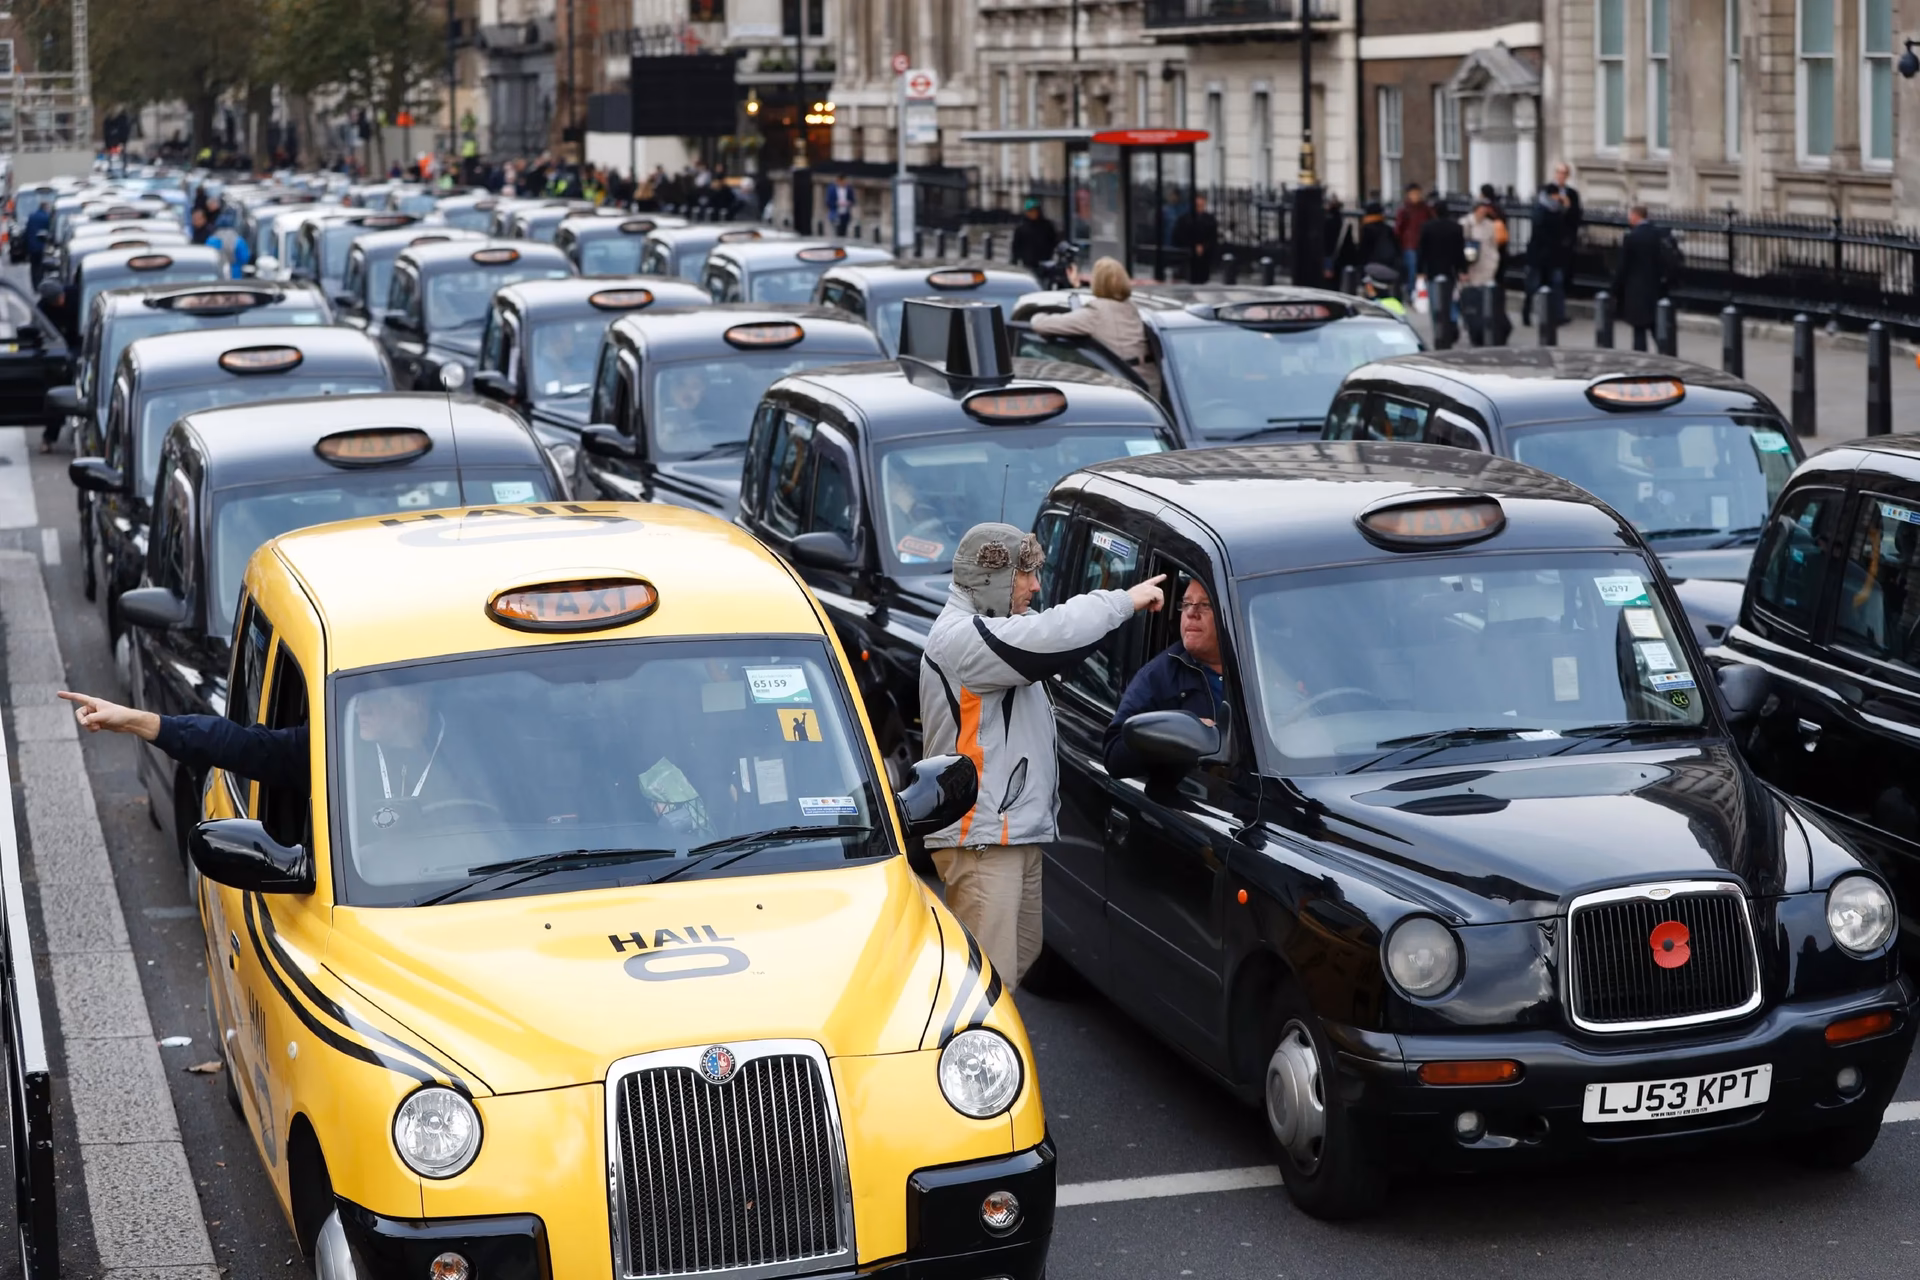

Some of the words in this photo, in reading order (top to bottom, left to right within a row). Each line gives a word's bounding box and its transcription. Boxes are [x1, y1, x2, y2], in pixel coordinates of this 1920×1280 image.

[1262, 305, 1314, 319] TAXI
[1615, 382, 1671, 397] TAXI
[992, 395, 1050, 411] TAXI
[341, 435, 408, 453] TAXI
[379, 504, 620, 529] HAIL
[1402, 508, 1479, 532] TAXI
[1601, 585, 1629, 593] 64297
[530, 588, 627, 617] TAXI
[753, 679, 787, 688] 65159
[608, 925, 735, 952] HAIL
[1598, 1081, 1688, 1114] LJ53
[1696, 1069, 1759, 1107] KPT
